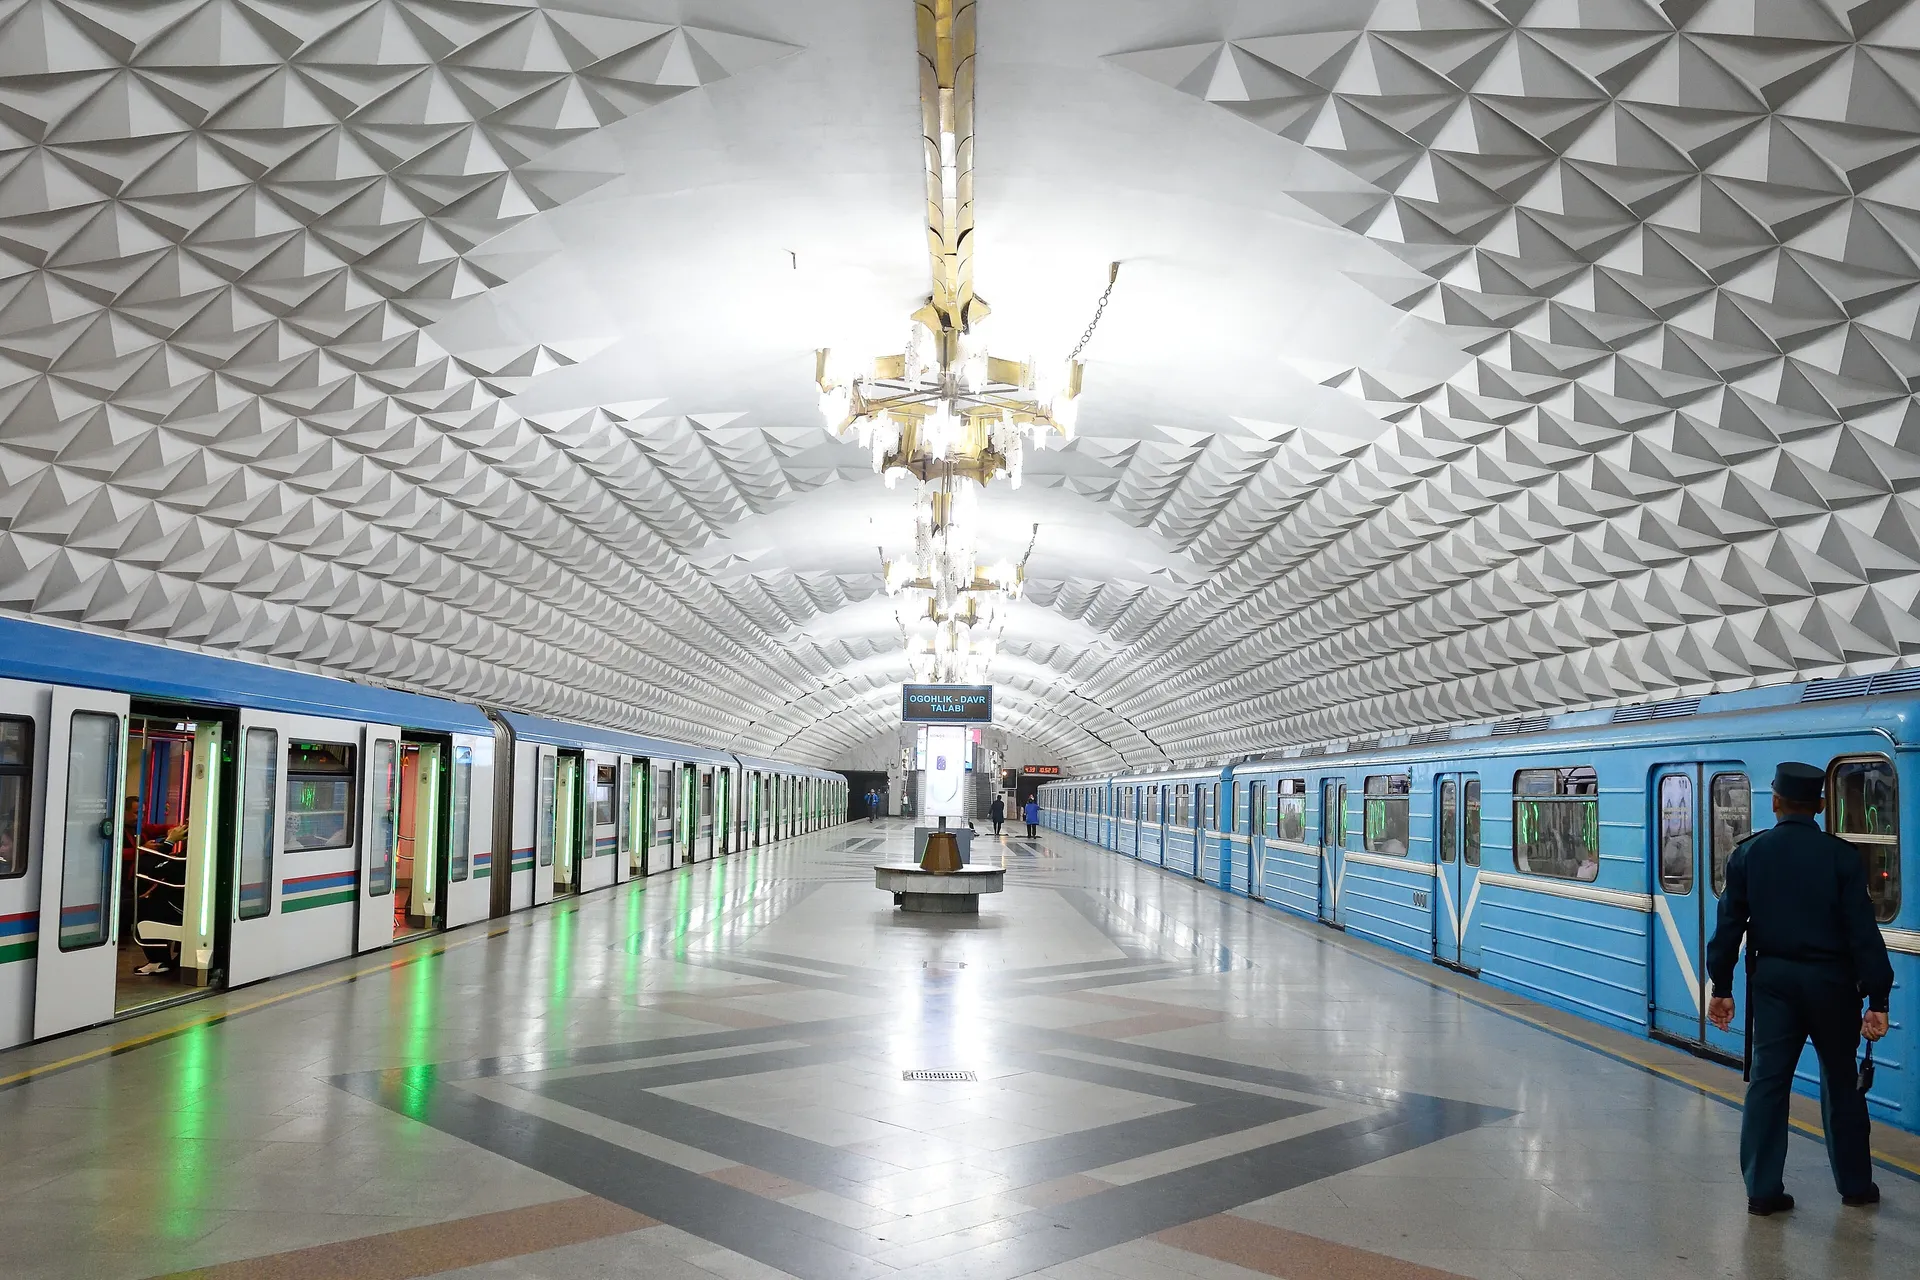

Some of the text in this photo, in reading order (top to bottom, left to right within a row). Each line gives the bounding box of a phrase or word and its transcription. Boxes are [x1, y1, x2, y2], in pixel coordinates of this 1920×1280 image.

[909, 695, 952, 703] OGOHLIK
[960, 695, 986, 703] DAVR
[931, 704, 964, 712] TALABI
